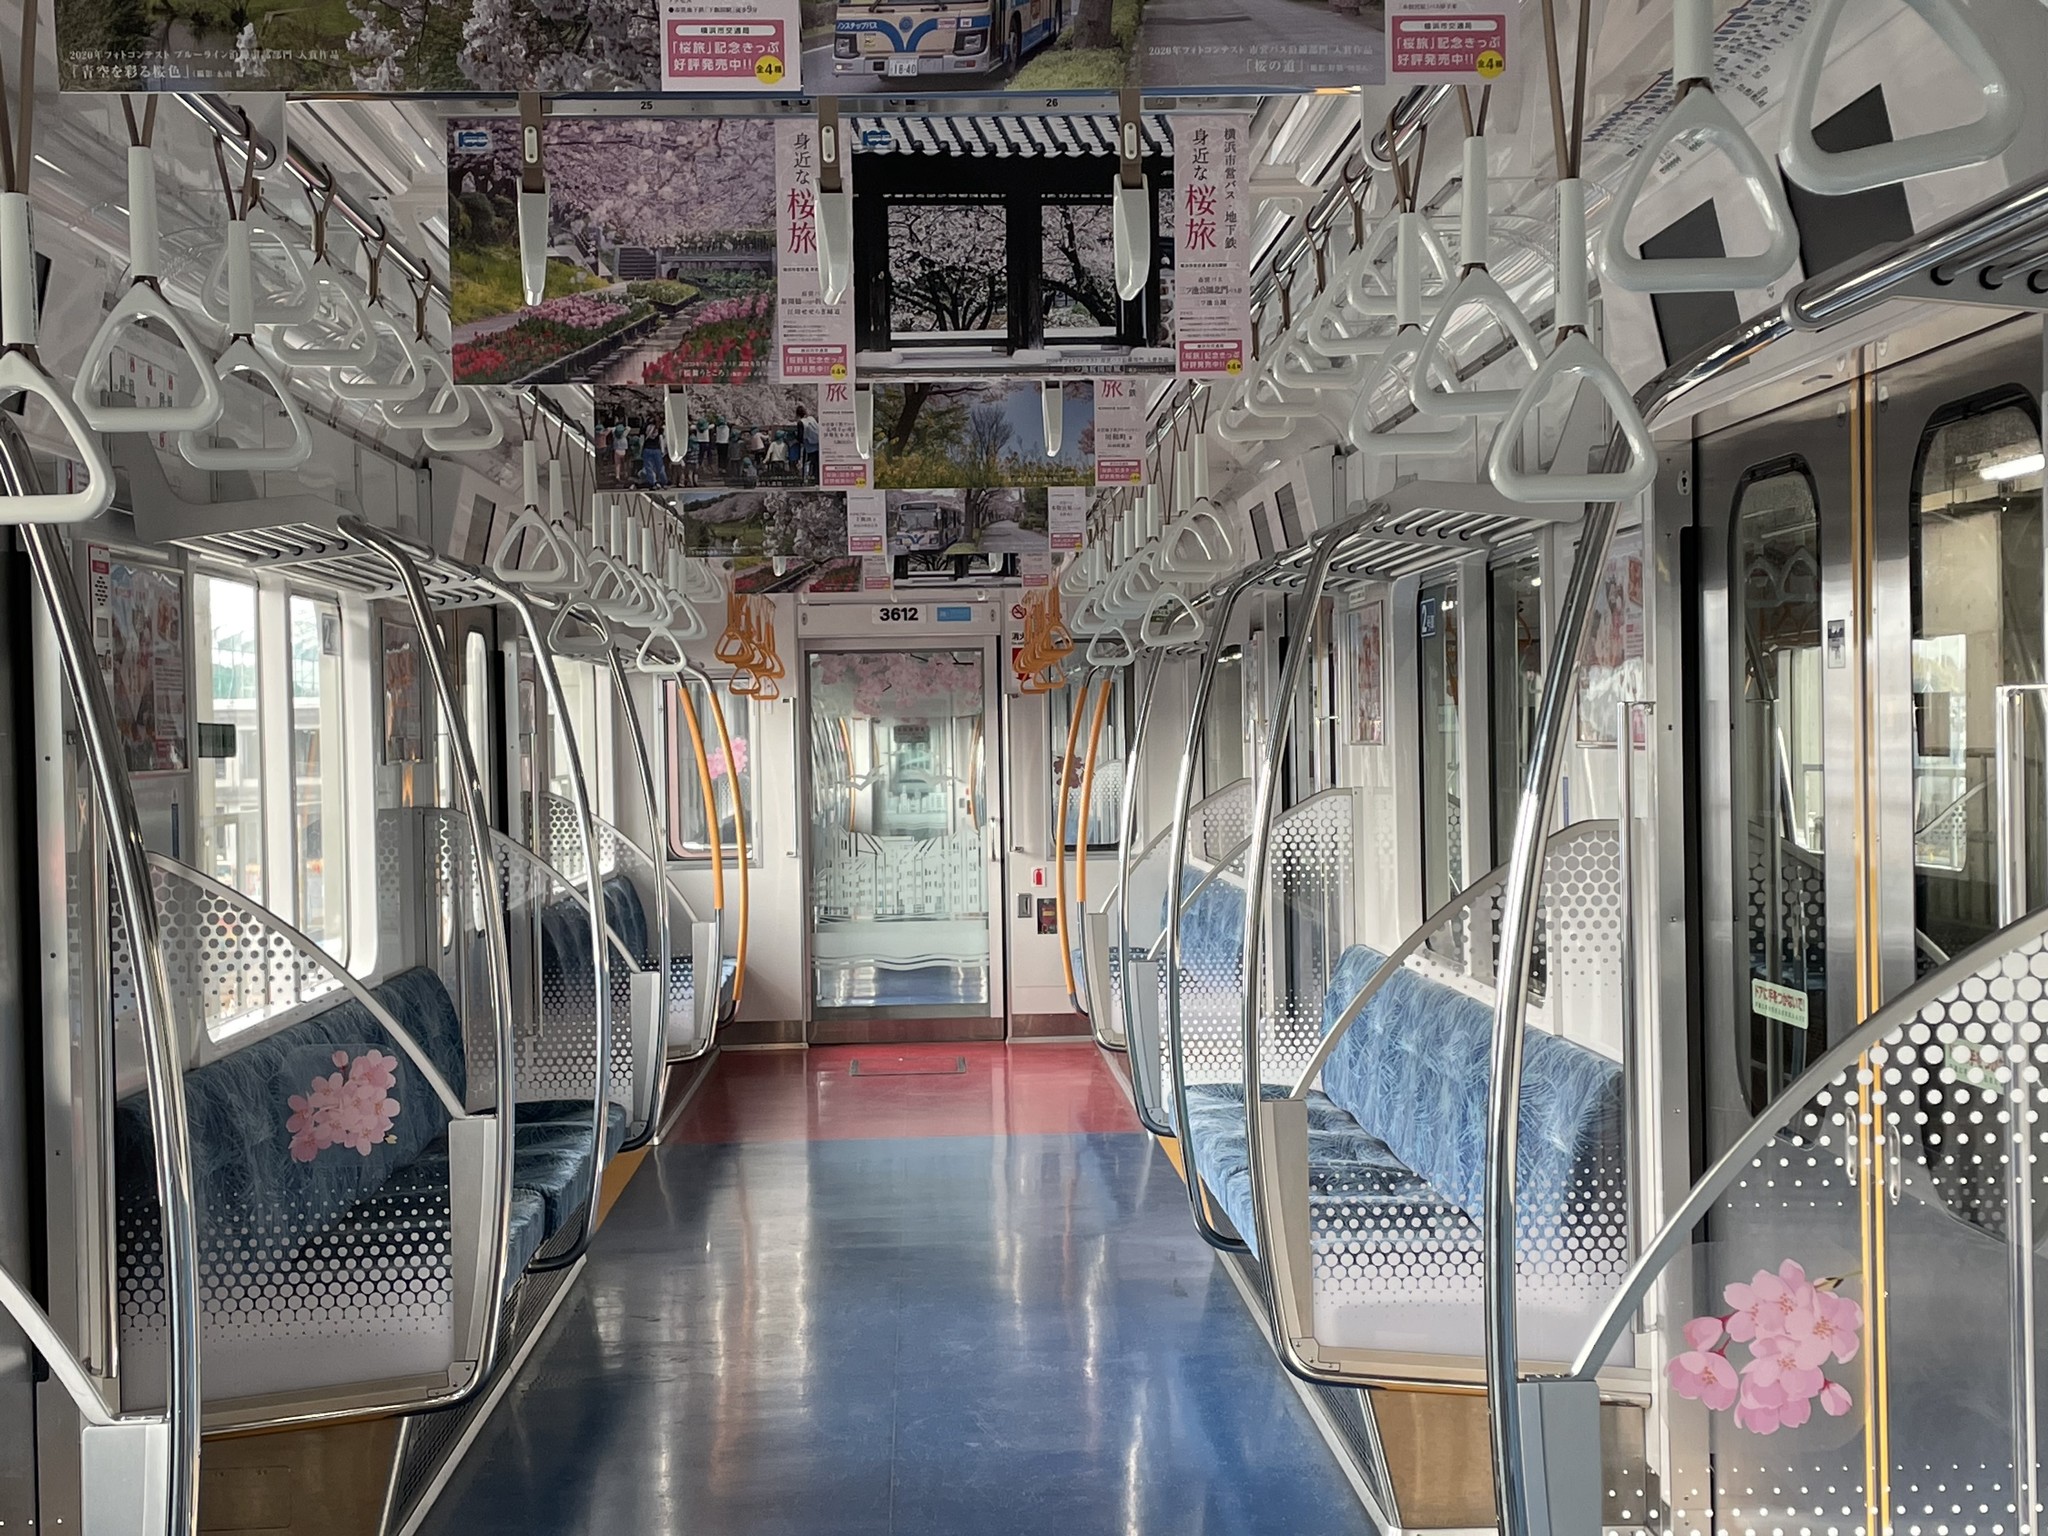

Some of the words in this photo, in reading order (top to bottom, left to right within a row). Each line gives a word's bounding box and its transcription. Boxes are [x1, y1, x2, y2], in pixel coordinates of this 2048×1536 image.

[700, 26, 751, 35] 横浜市交通局
[1424, 22, 1472, 30] 横浜市交通局
[672, 41, 780, 55] 「桜旅」記念きっぷ
[1396, 35, 1501, 50] 「桜旅」記念きっぷ
[72, 64, 189, 80] 「青空を彩る桜色」
[640, 100, 653, 110] 25
[1046, 98, 1058, 107] 26
[1224, 127, 1238, 250] 横浜市営バス・地下鉄
[879, 607, 919, 622] 3612
